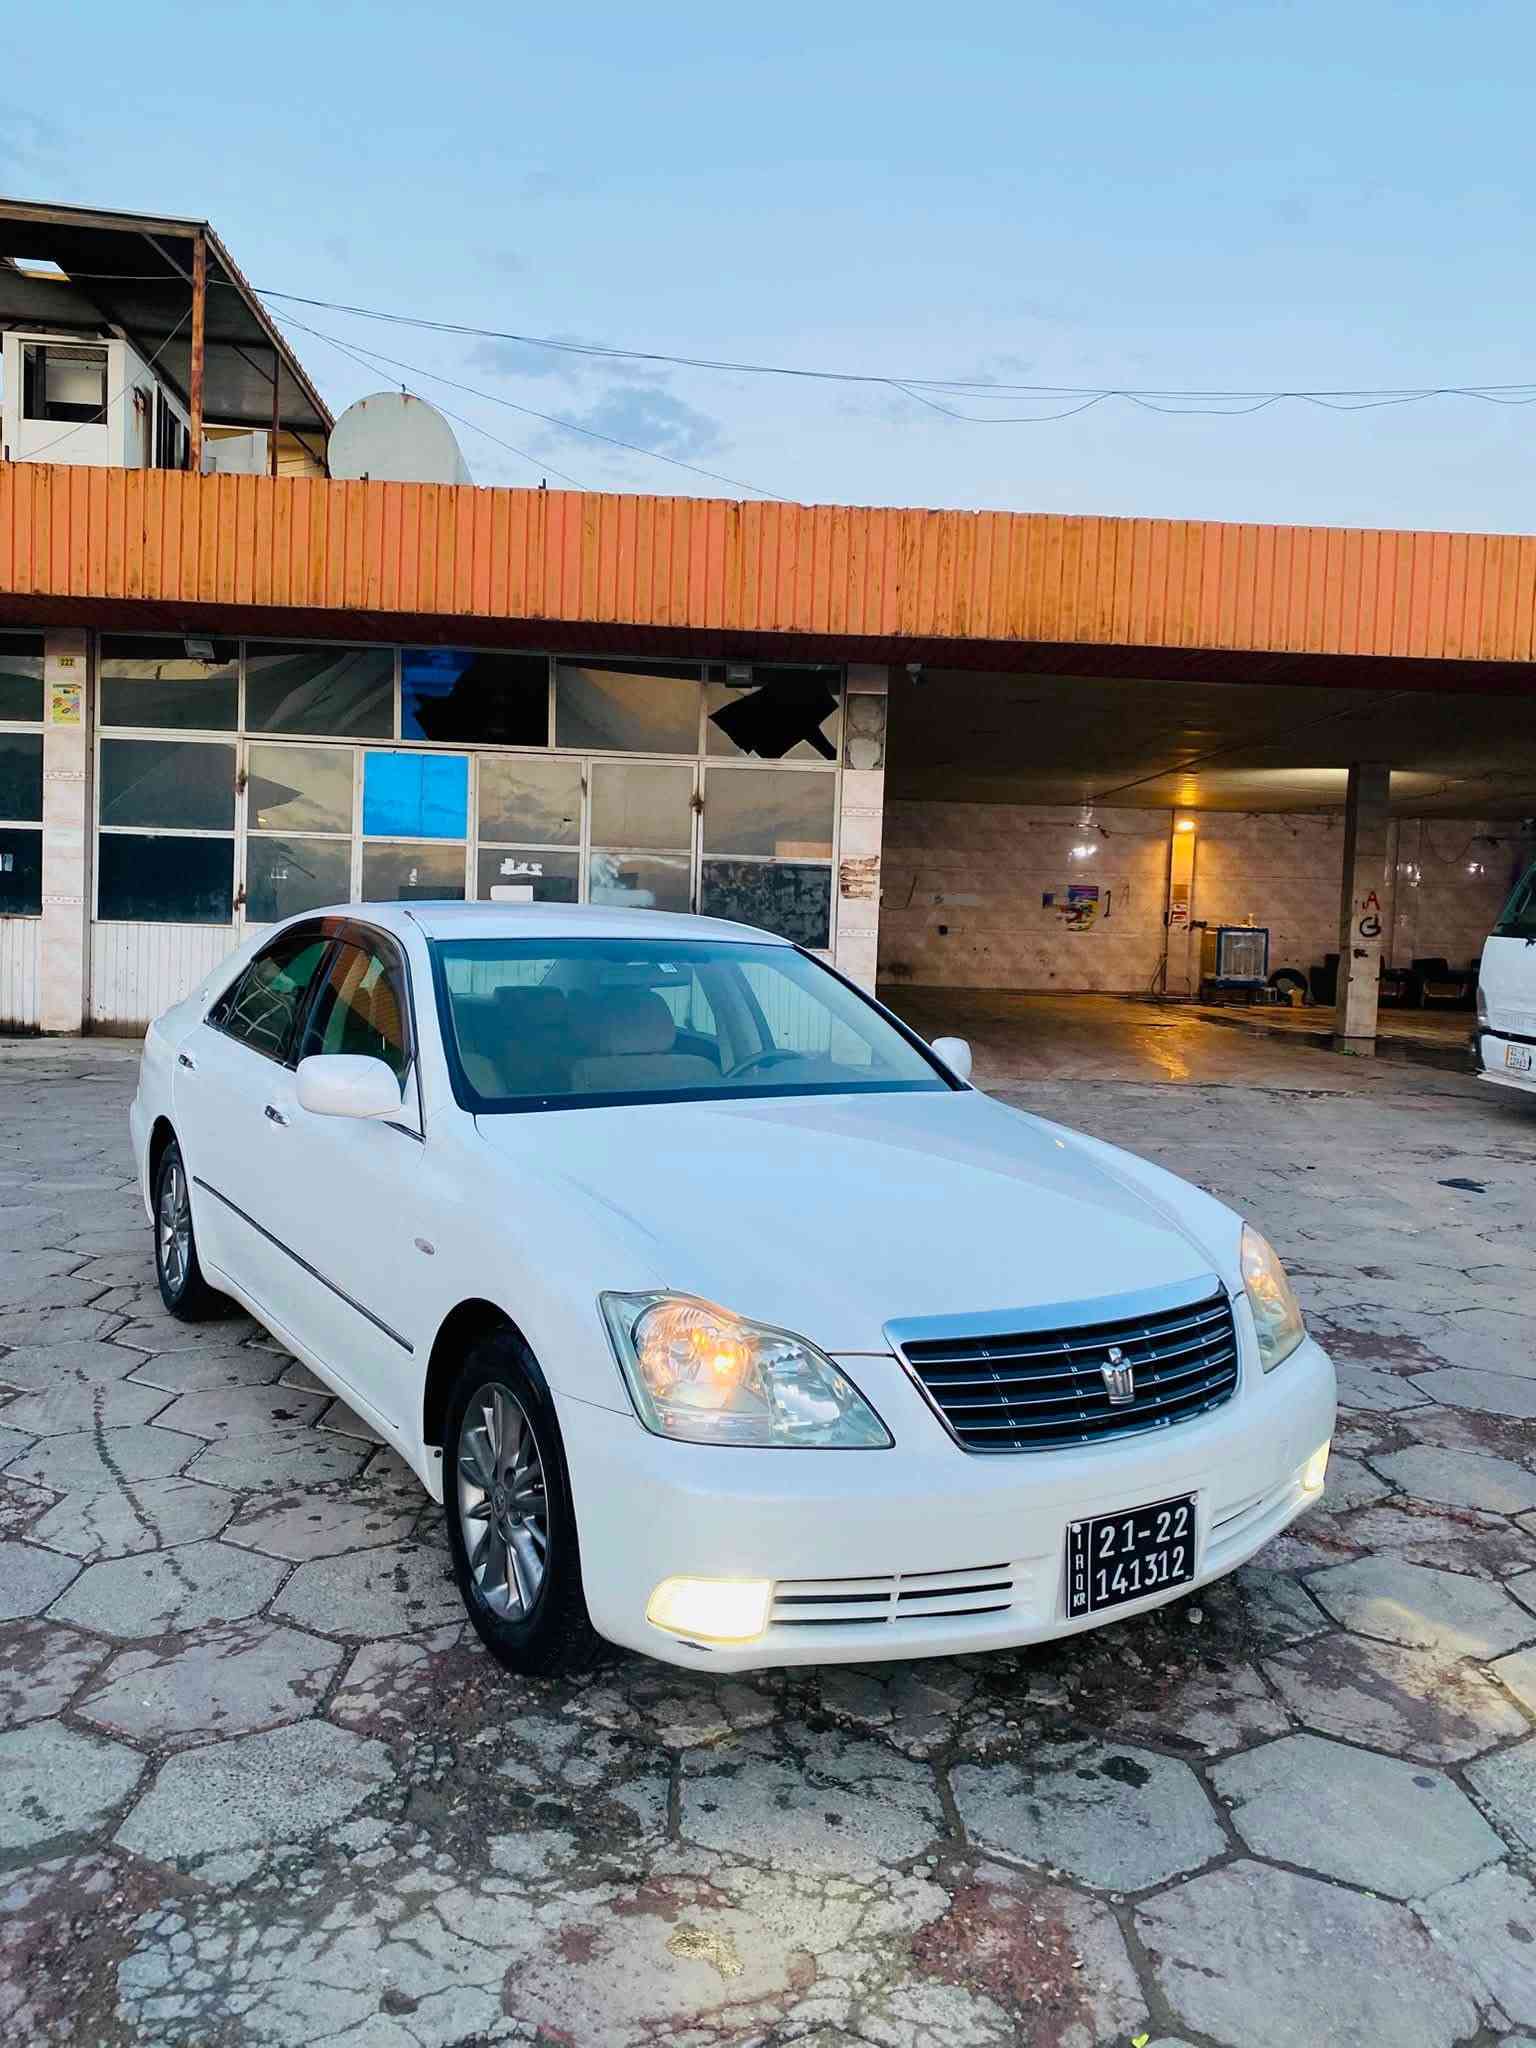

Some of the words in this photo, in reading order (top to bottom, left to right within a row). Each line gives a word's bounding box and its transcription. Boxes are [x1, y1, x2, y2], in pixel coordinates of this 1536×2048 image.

[1099, 1506, 1188, 1559] 21-22
[1073, 1592, 1086, 1607] KR
[1096, 1546, 1185, 1601] 141312
